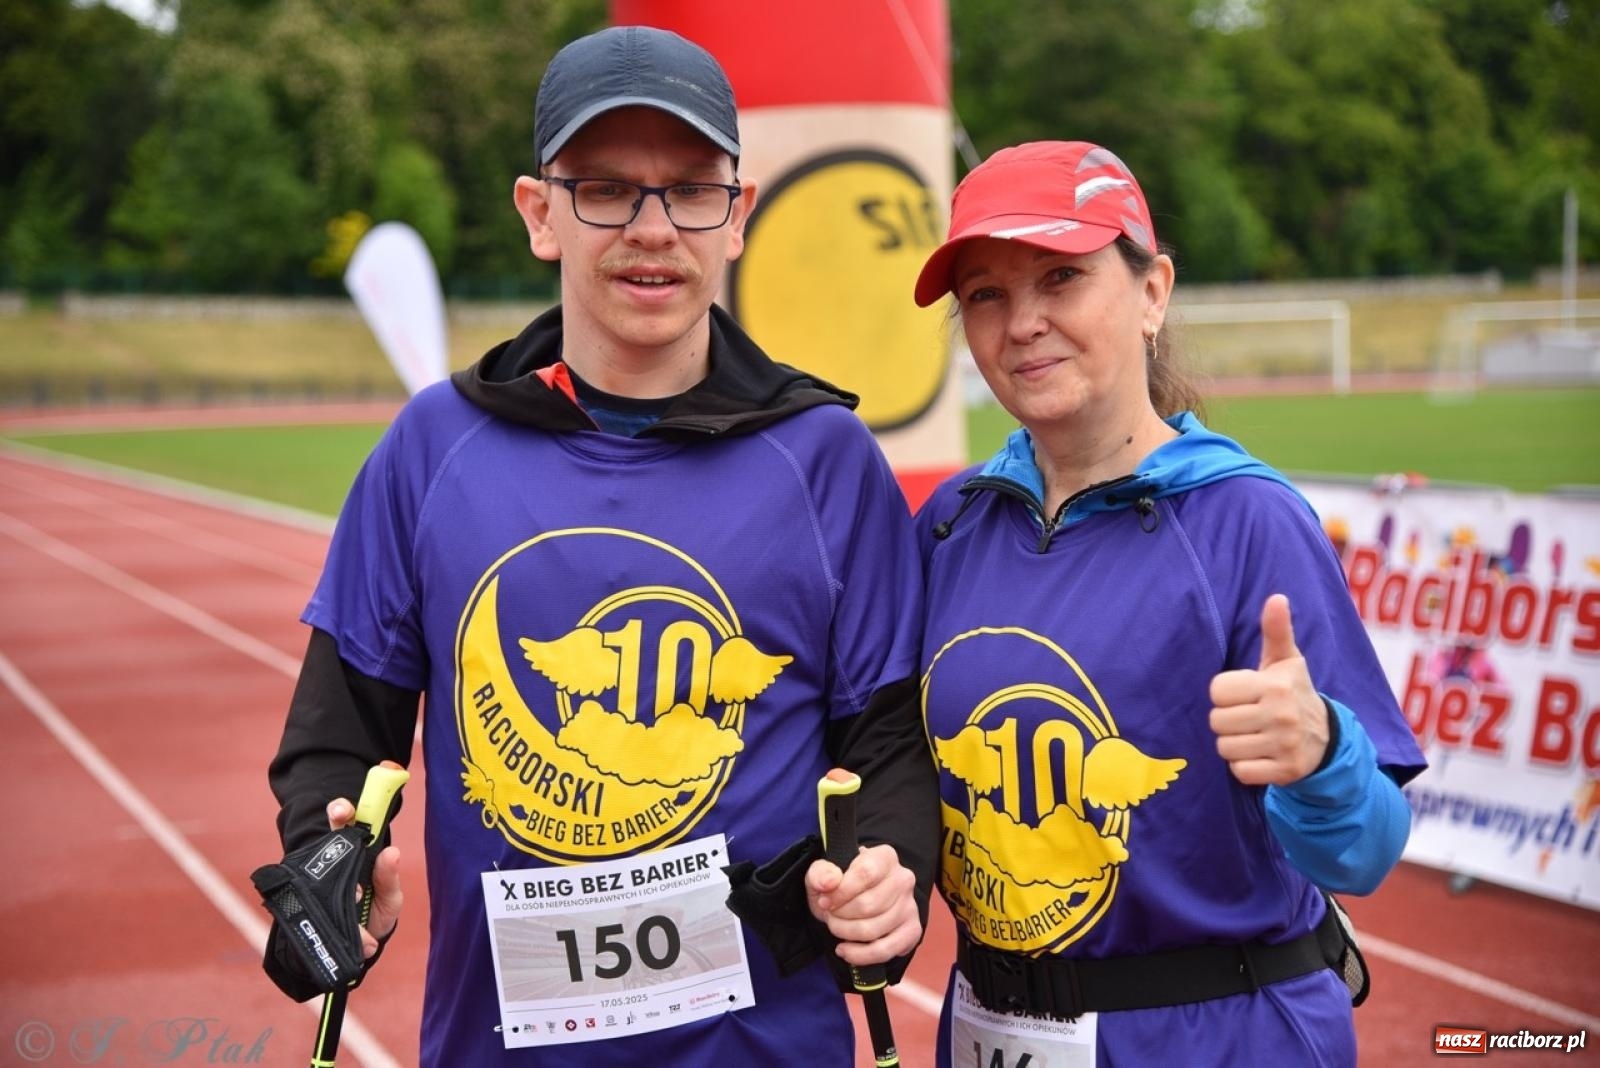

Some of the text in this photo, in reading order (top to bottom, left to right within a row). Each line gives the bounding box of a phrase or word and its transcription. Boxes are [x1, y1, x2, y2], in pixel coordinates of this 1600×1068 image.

[602, 618, 713, 723] 10
[1404, 652, 1512, 753] bez
[473, 681, 605, 818] RACIBORSKI
[985, 717, 1085, 825] 10
[526, 797, 678, 847] BIEG BEZ BARIER
[504, 852, 710, 901] X BIEG BEZ BARIER
[299, 918, 340, 982] GABEL
[555, 914, 682, 983] 150
[600, 993, 649, 1009] 17.05.2025
